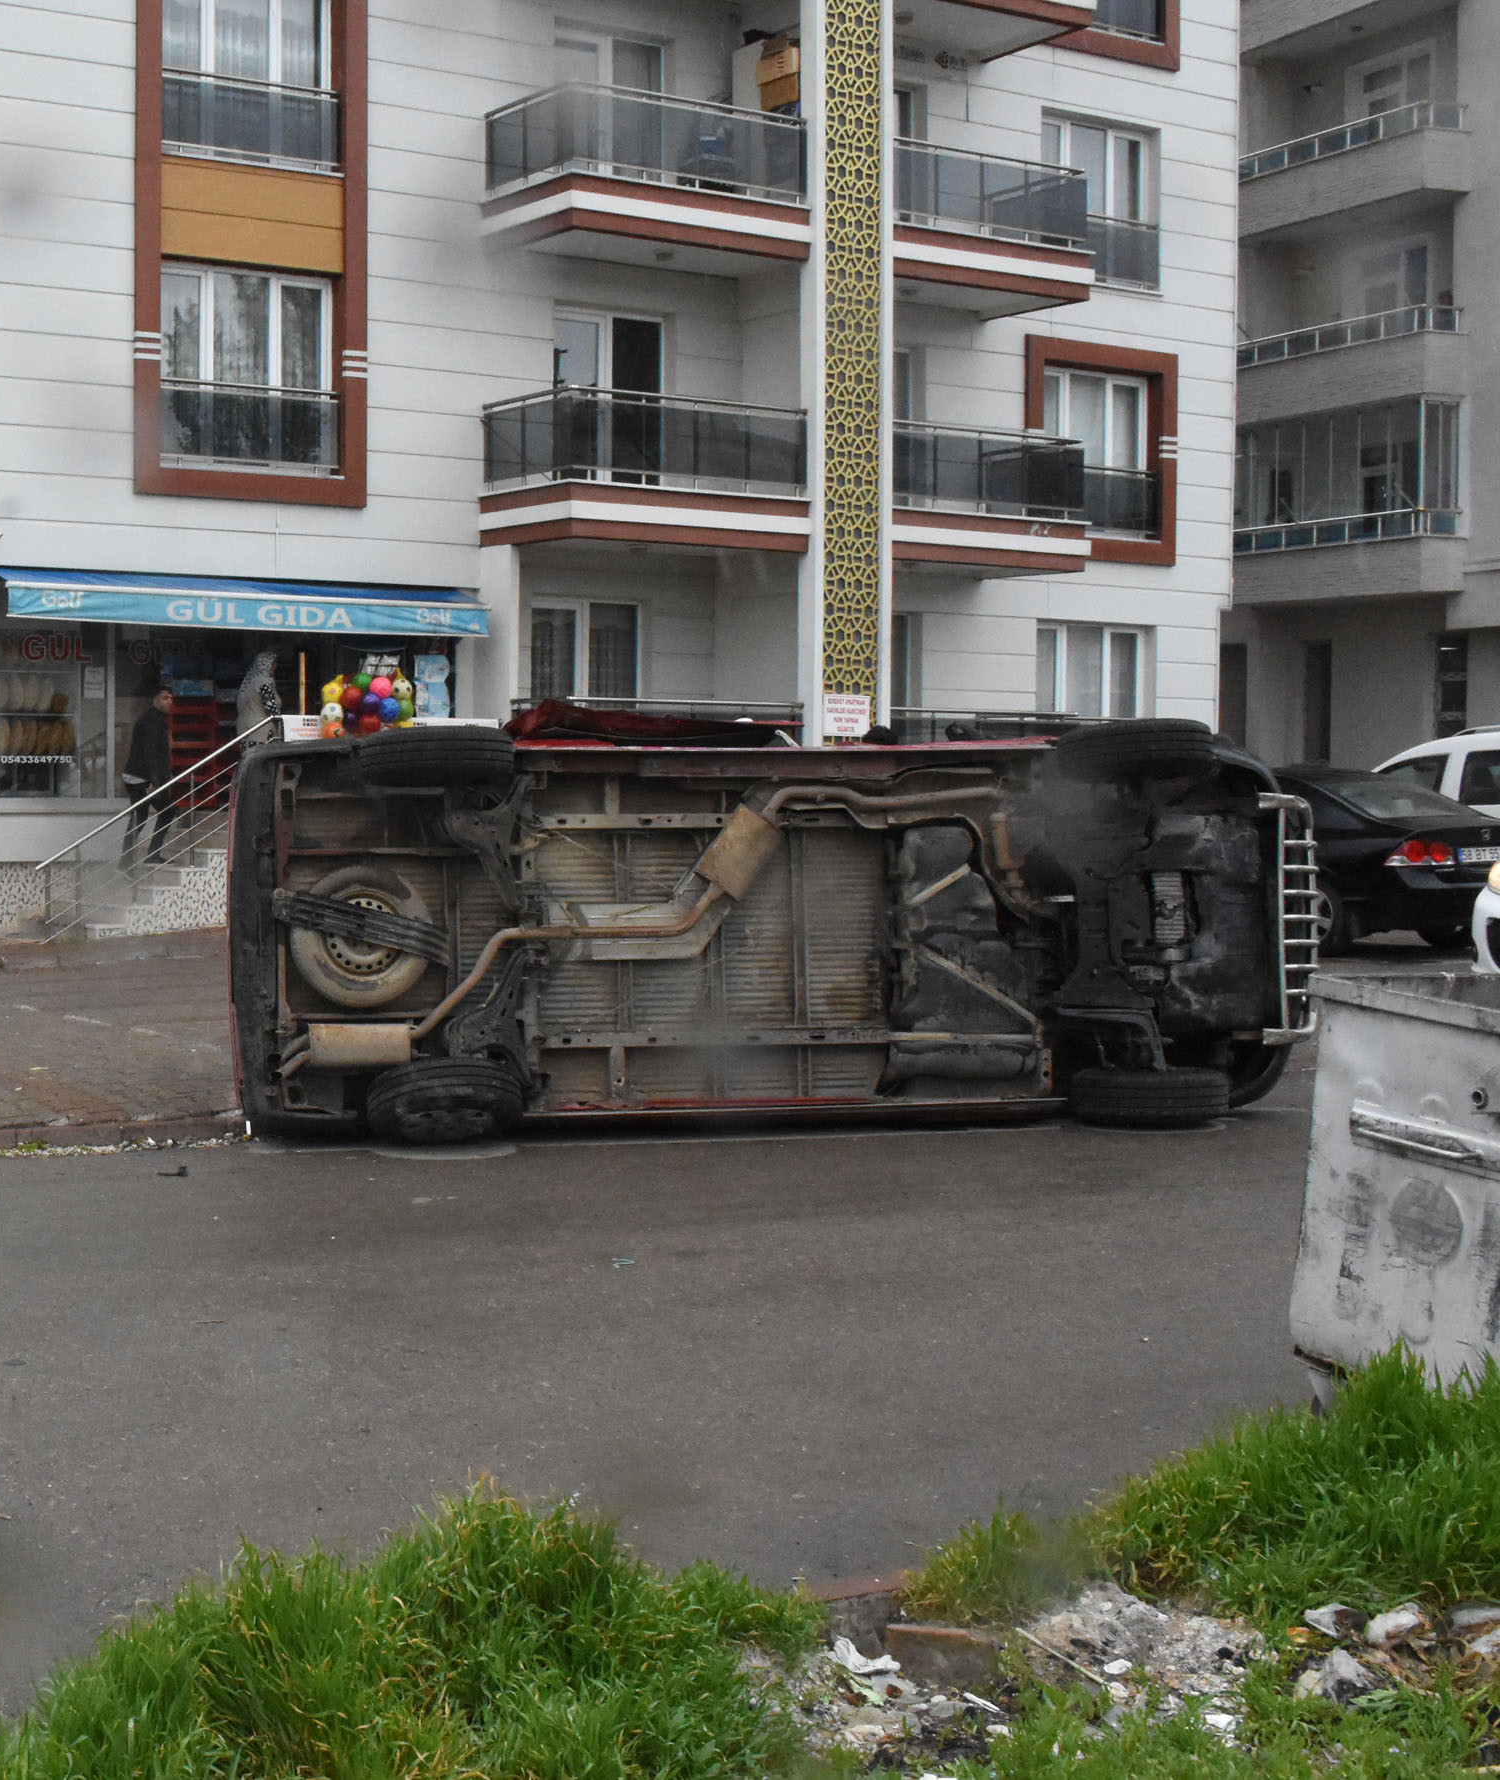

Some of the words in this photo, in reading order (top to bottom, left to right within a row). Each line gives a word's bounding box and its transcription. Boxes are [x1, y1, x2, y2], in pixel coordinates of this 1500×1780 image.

[166, 597, 245, 625] GÜL
[257, 605, 353, 628] GIDA
[22, 630, 92, 663] GÜL
